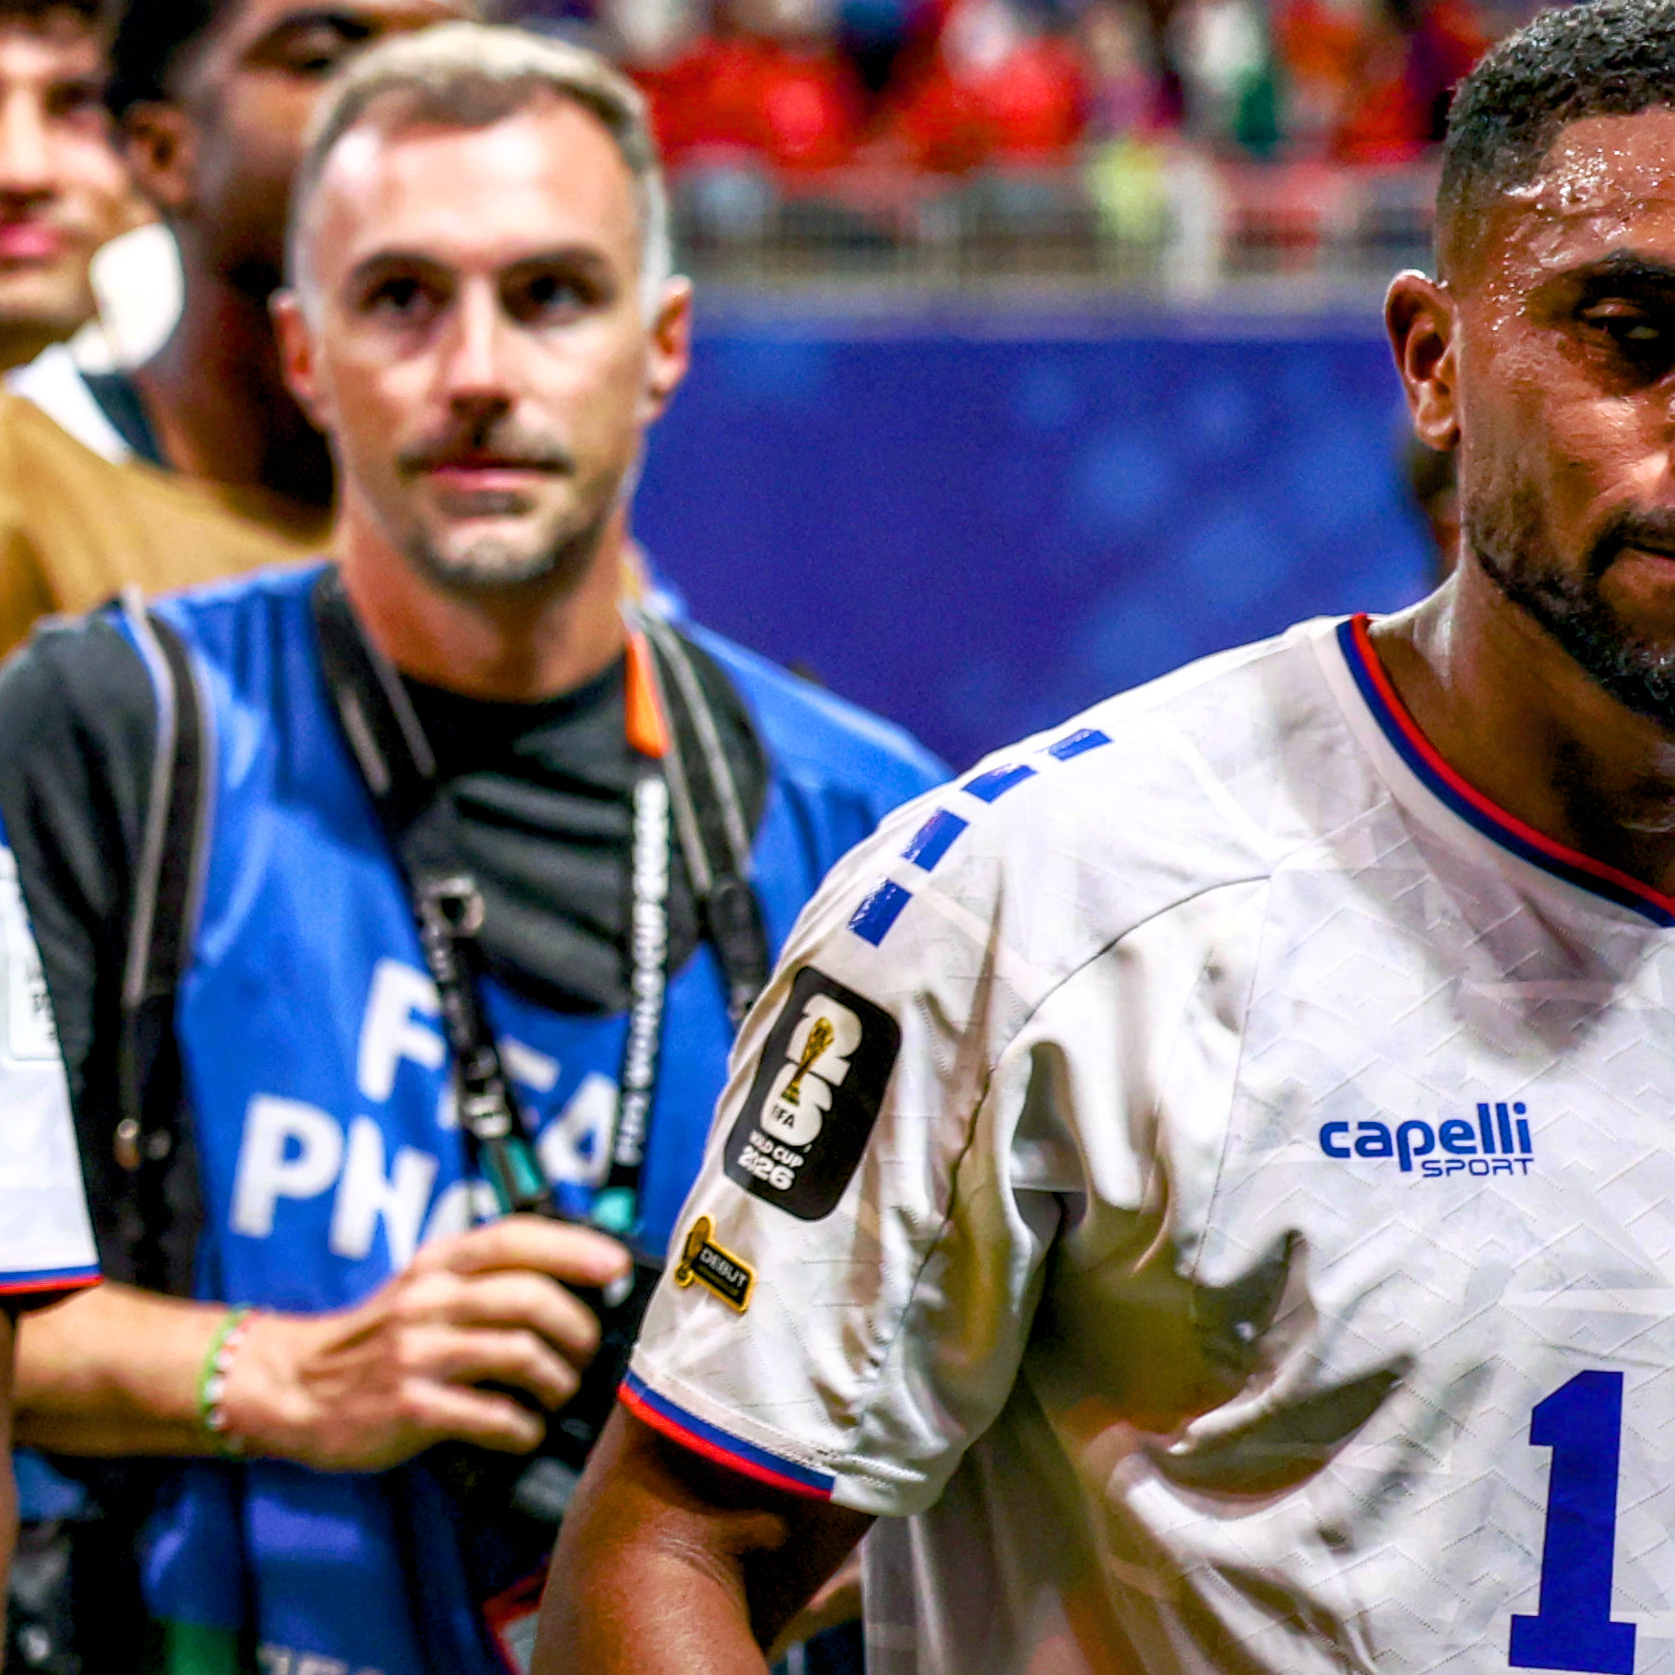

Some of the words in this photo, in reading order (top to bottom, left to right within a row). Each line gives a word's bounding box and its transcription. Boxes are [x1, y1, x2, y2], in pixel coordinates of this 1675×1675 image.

[358, 957, 619, 1187] FA
[772, 1146, 805, 1168] CUP
[1319, 1101, 1533, 1173] capelli
[1421, 1158, 1534, 1178] SPORT
[699, 1246, 748, 1287] DEBUT
[1508, 1369, 1637, 1675] 1
